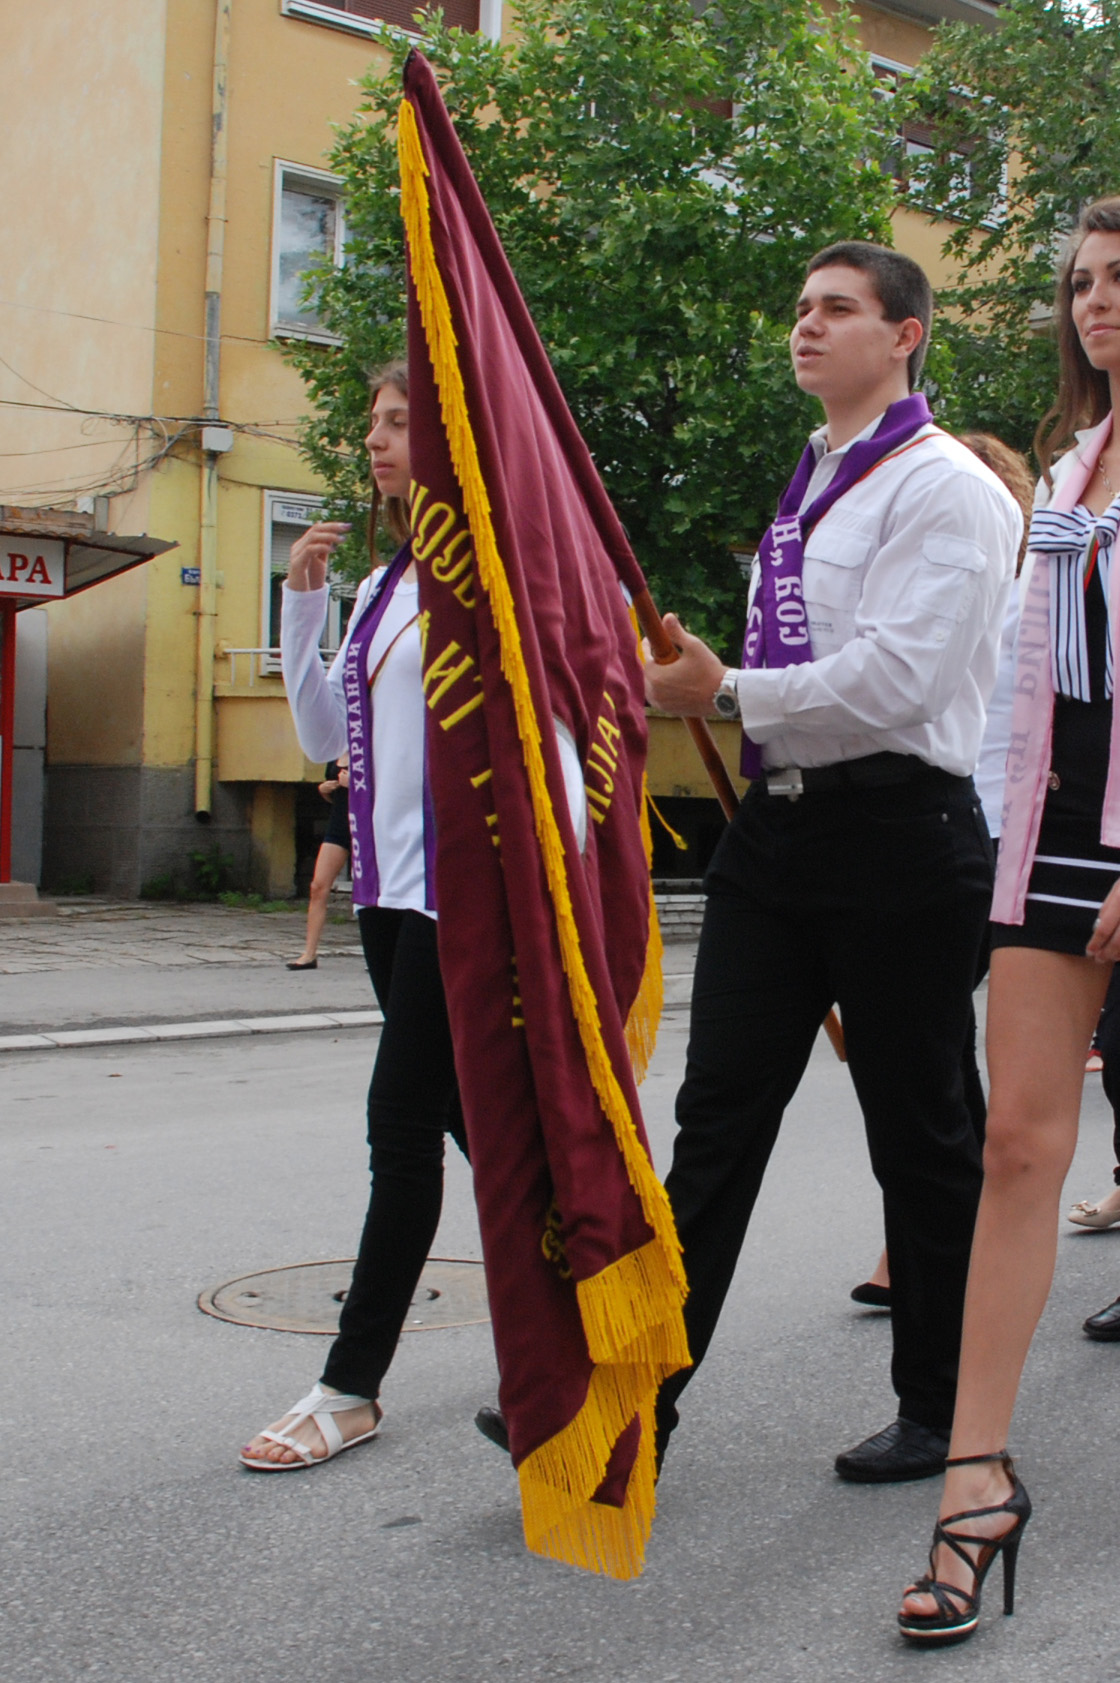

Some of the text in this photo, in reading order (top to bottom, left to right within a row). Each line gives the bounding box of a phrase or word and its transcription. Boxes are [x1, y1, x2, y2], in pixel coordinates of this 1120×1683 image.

[0, 553, 52, 584] РА
[774, 576, 809, 646] СОУ
[344, 641, 367, 792] ХАРМАНЛИ
